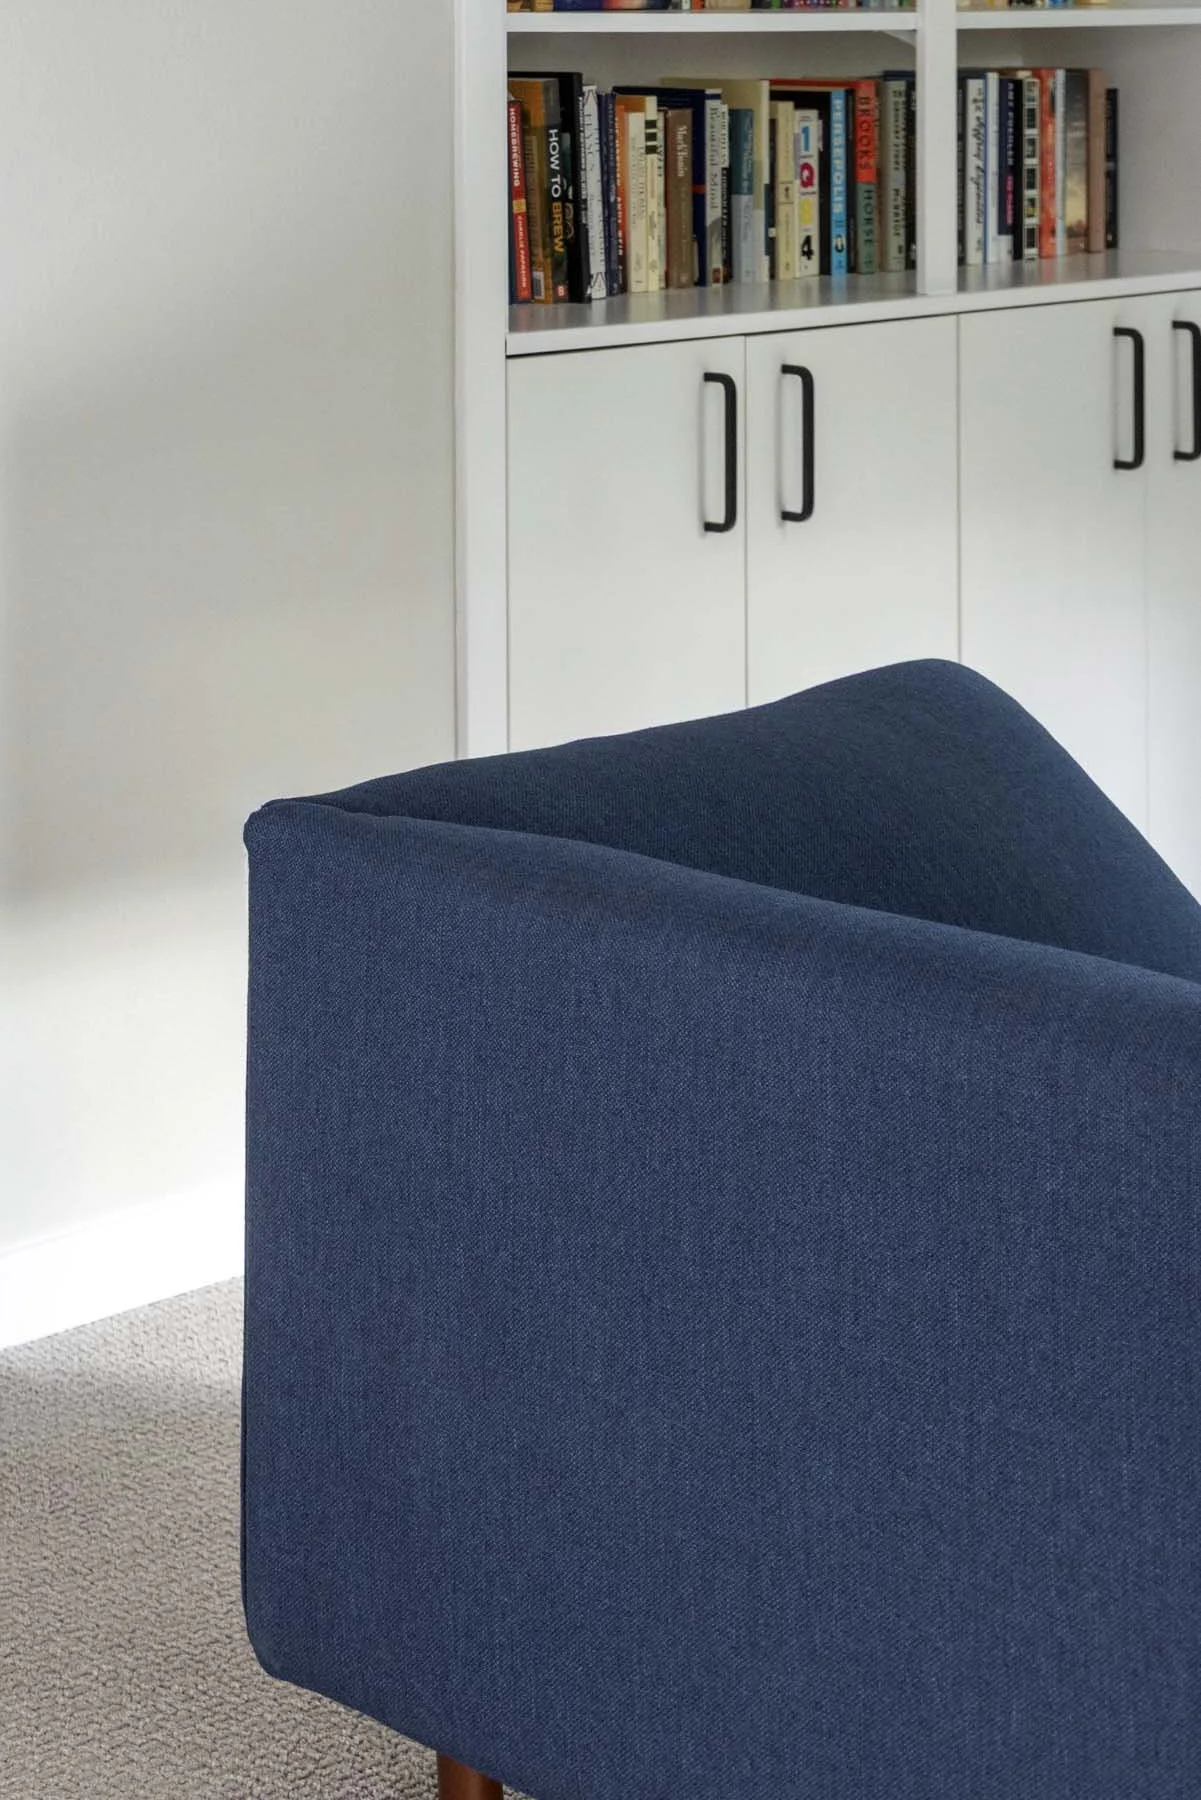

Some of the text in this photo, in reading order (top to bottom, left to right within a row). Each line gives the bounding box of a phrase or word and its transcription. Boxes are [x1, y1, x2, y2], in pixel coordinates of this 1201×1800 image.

[508, 108, 521, 187] HOMEBREWING
[832, 99, 845, 214] PERSEPOLIS
[859, 96, 873, 170] BROOKS
[548, 129, 565, 253] HOW TO BREW
[863, 189, 874, 246] HORSE
